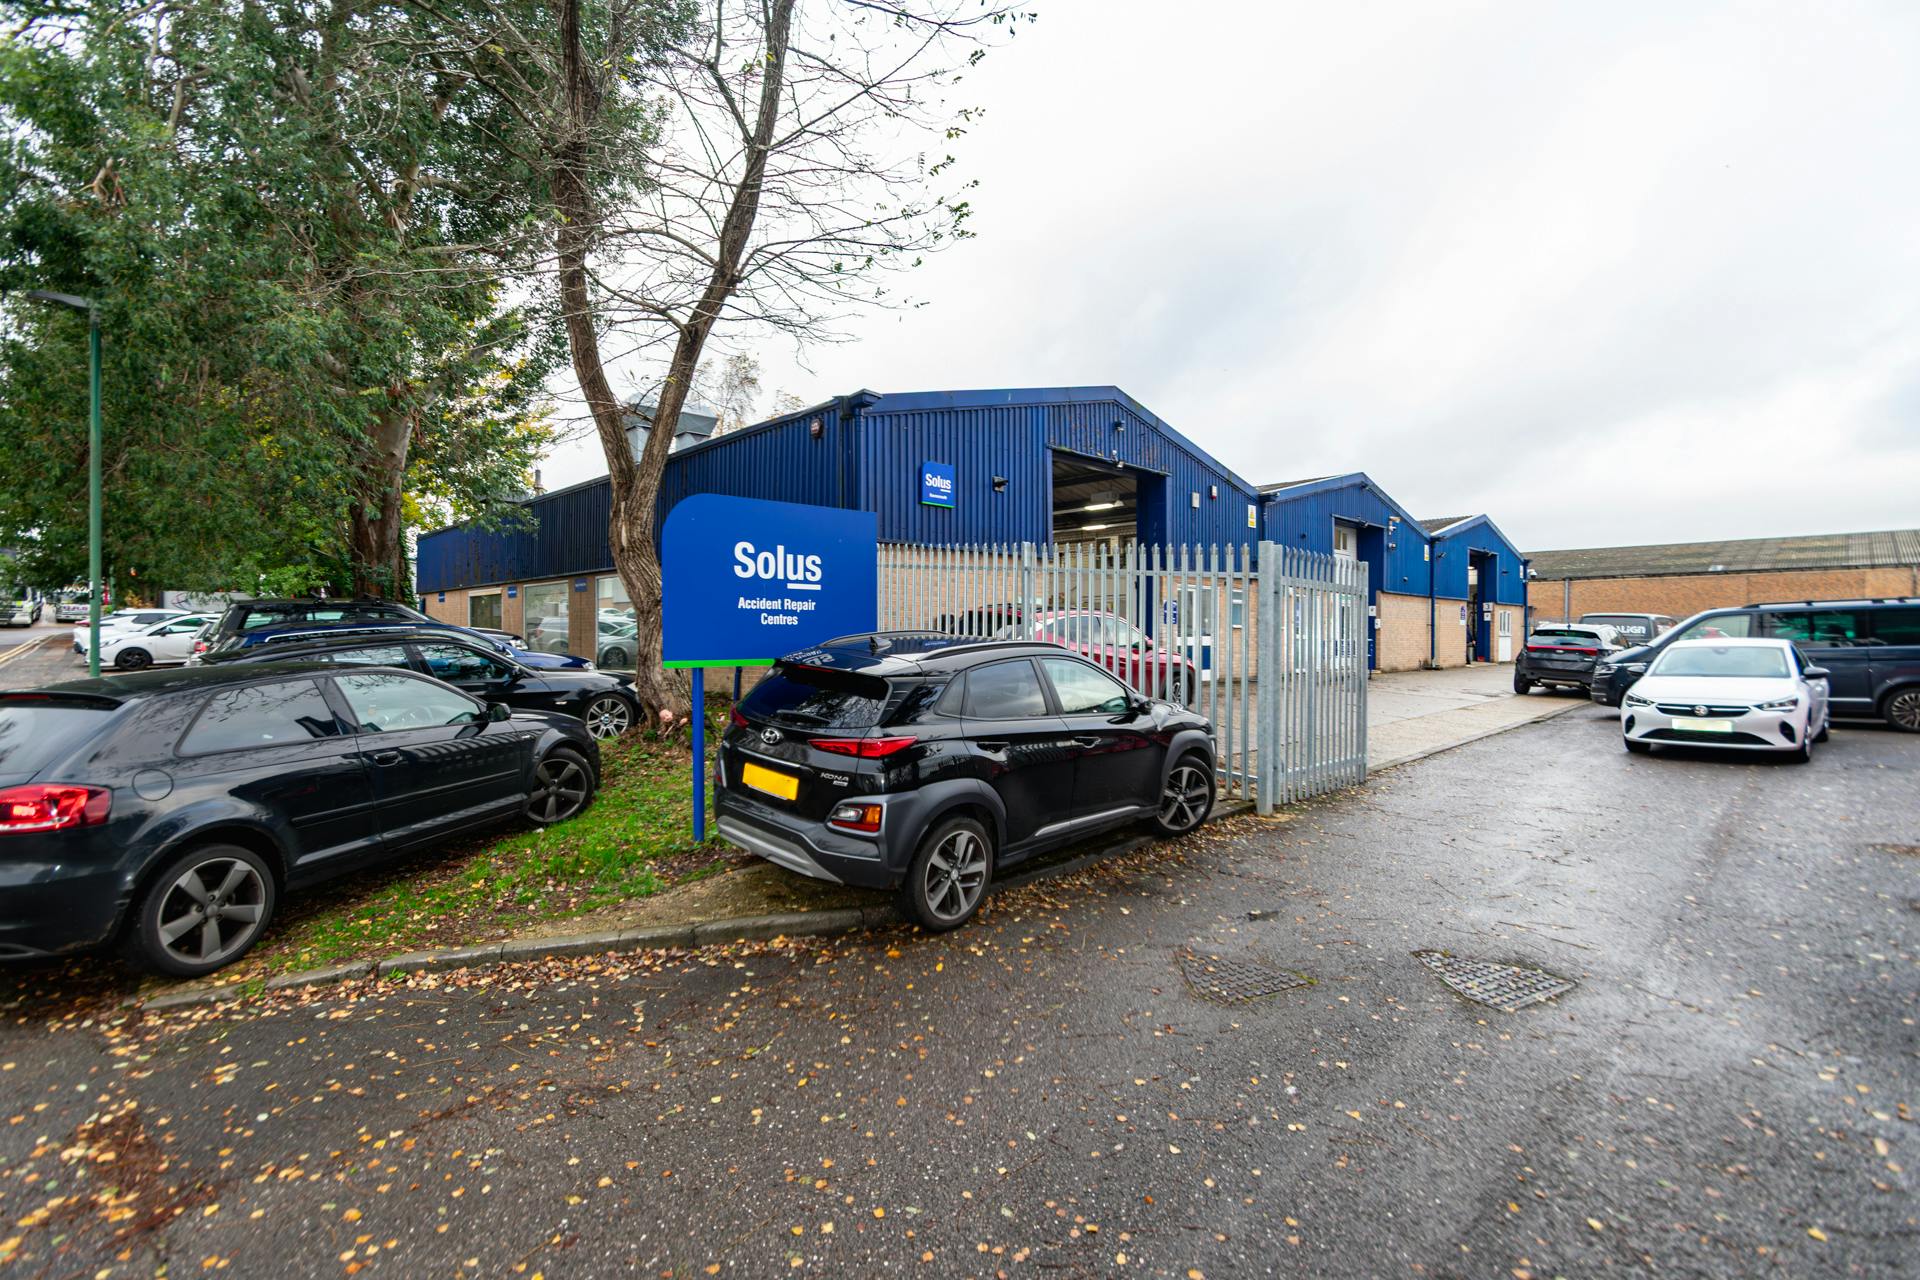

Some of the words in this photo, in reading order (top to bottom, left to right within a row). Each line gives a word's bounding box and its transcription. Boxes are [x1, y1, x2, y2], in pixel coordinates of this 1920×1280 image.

[925, 473, 952, 490] Solus
[733, 541, 822, 582] Solus
[737, 597, 782, 610] Accident
[783, 598, 816, 613] Repair
[760, 612, 799, 626] Centres
[820, 772, 849, 781] KONA
